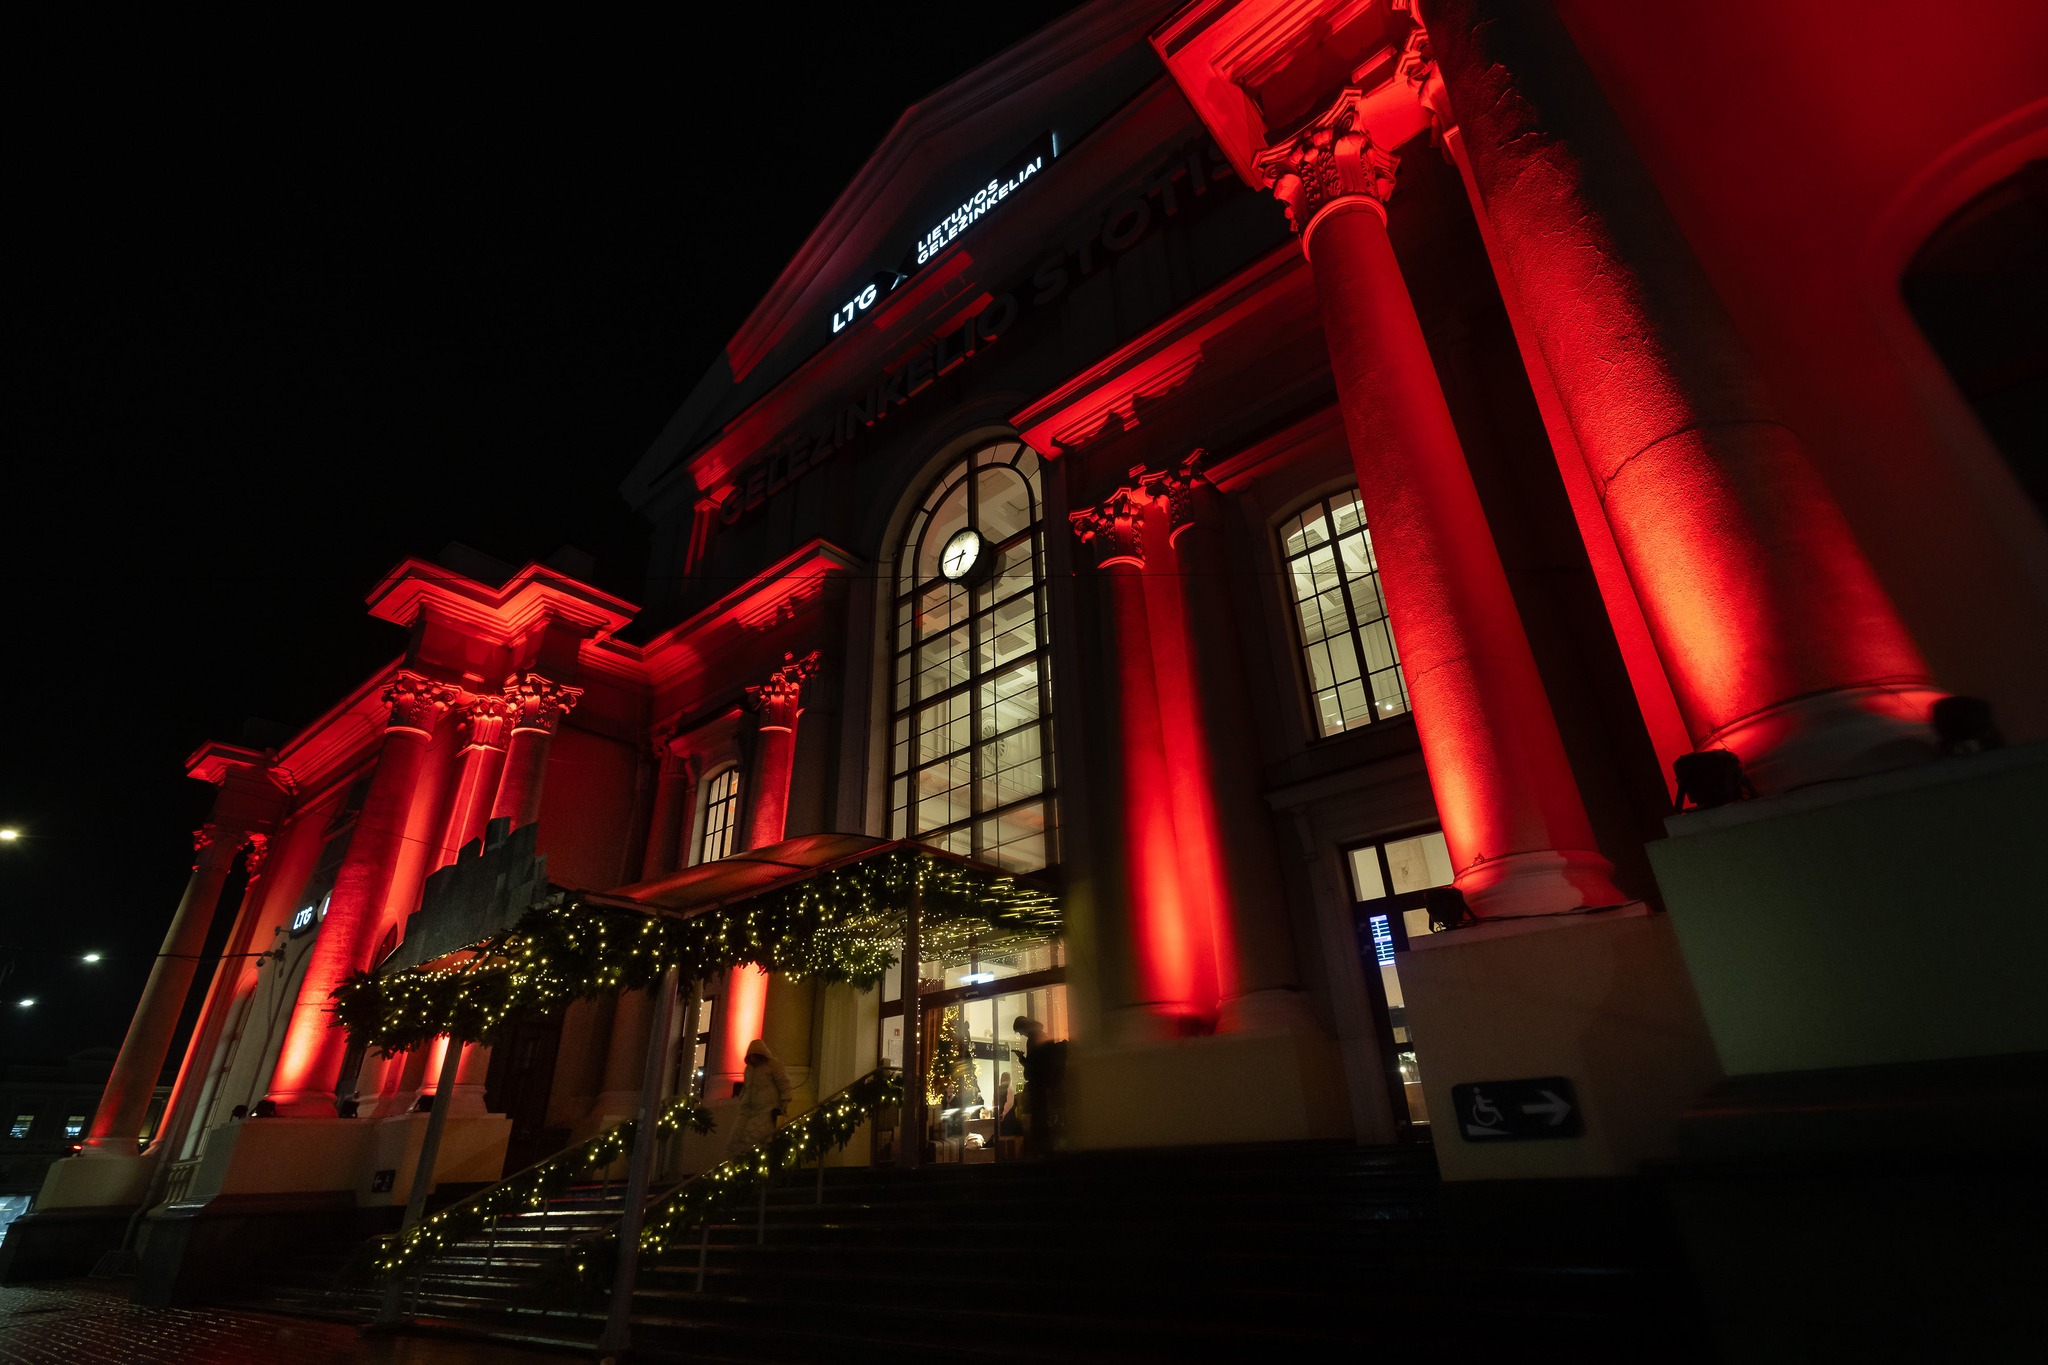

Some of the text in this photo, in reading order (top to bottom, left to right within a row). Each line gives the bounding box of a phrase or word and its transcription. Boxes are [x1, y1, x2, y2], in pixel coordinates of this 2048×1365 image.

[917, 178, 999, 252] LIETUVOS
[832, 283, 877, 334] LTG
[293, 906, 313, 930] LTG
